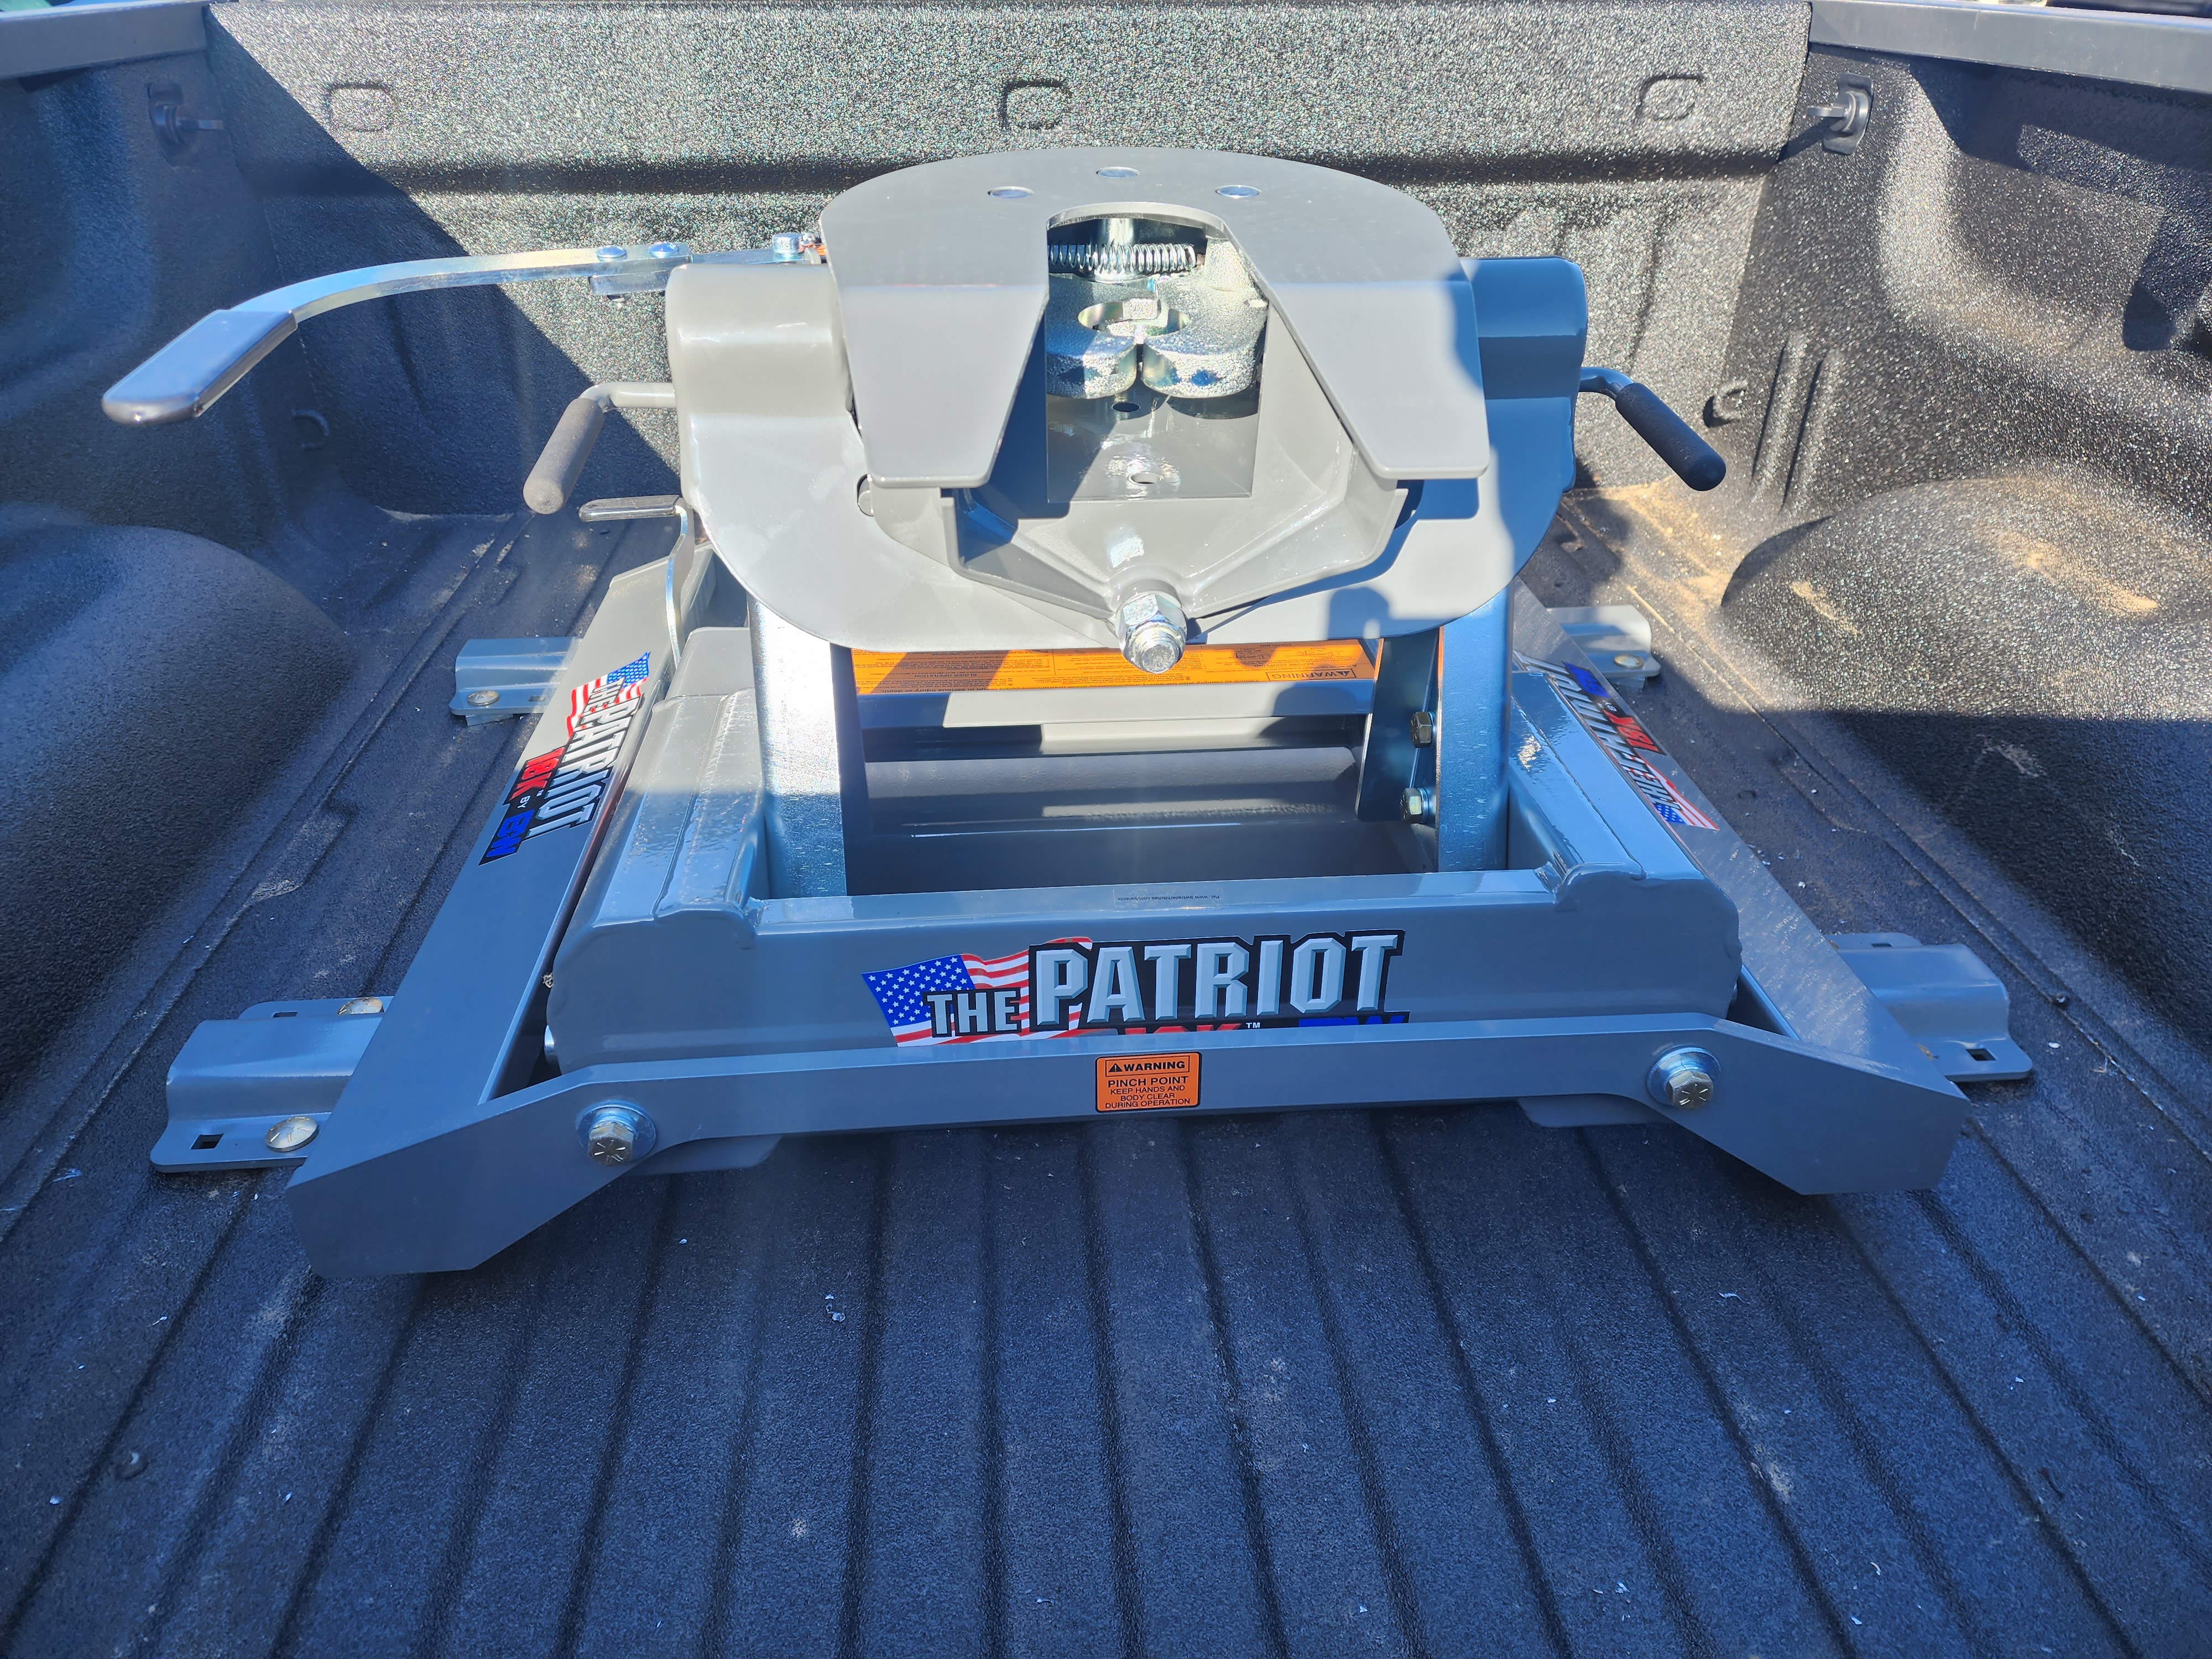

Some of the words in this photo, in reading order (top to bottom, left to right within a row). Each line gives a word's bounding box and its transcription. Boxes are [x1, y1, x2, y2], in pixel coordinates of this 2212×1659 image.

[583, 676, 625, 713] THE
[509, 747, 565, 801] 18K
[526, 697, 640, 838] PATRIOT
[517, 795, 531, 808] BY
[927, 990, 1020, 1036] THE
[1036, 935, 1398, 1025] PATRIOT
[1124, 1061, 1185, 1071] WARNING
[1108, 1078, 1146, 1088] PINCH
[1151, 1076, 1188, 1085] POINT
[1141, 1098, 1190, 1107] OPERATION
